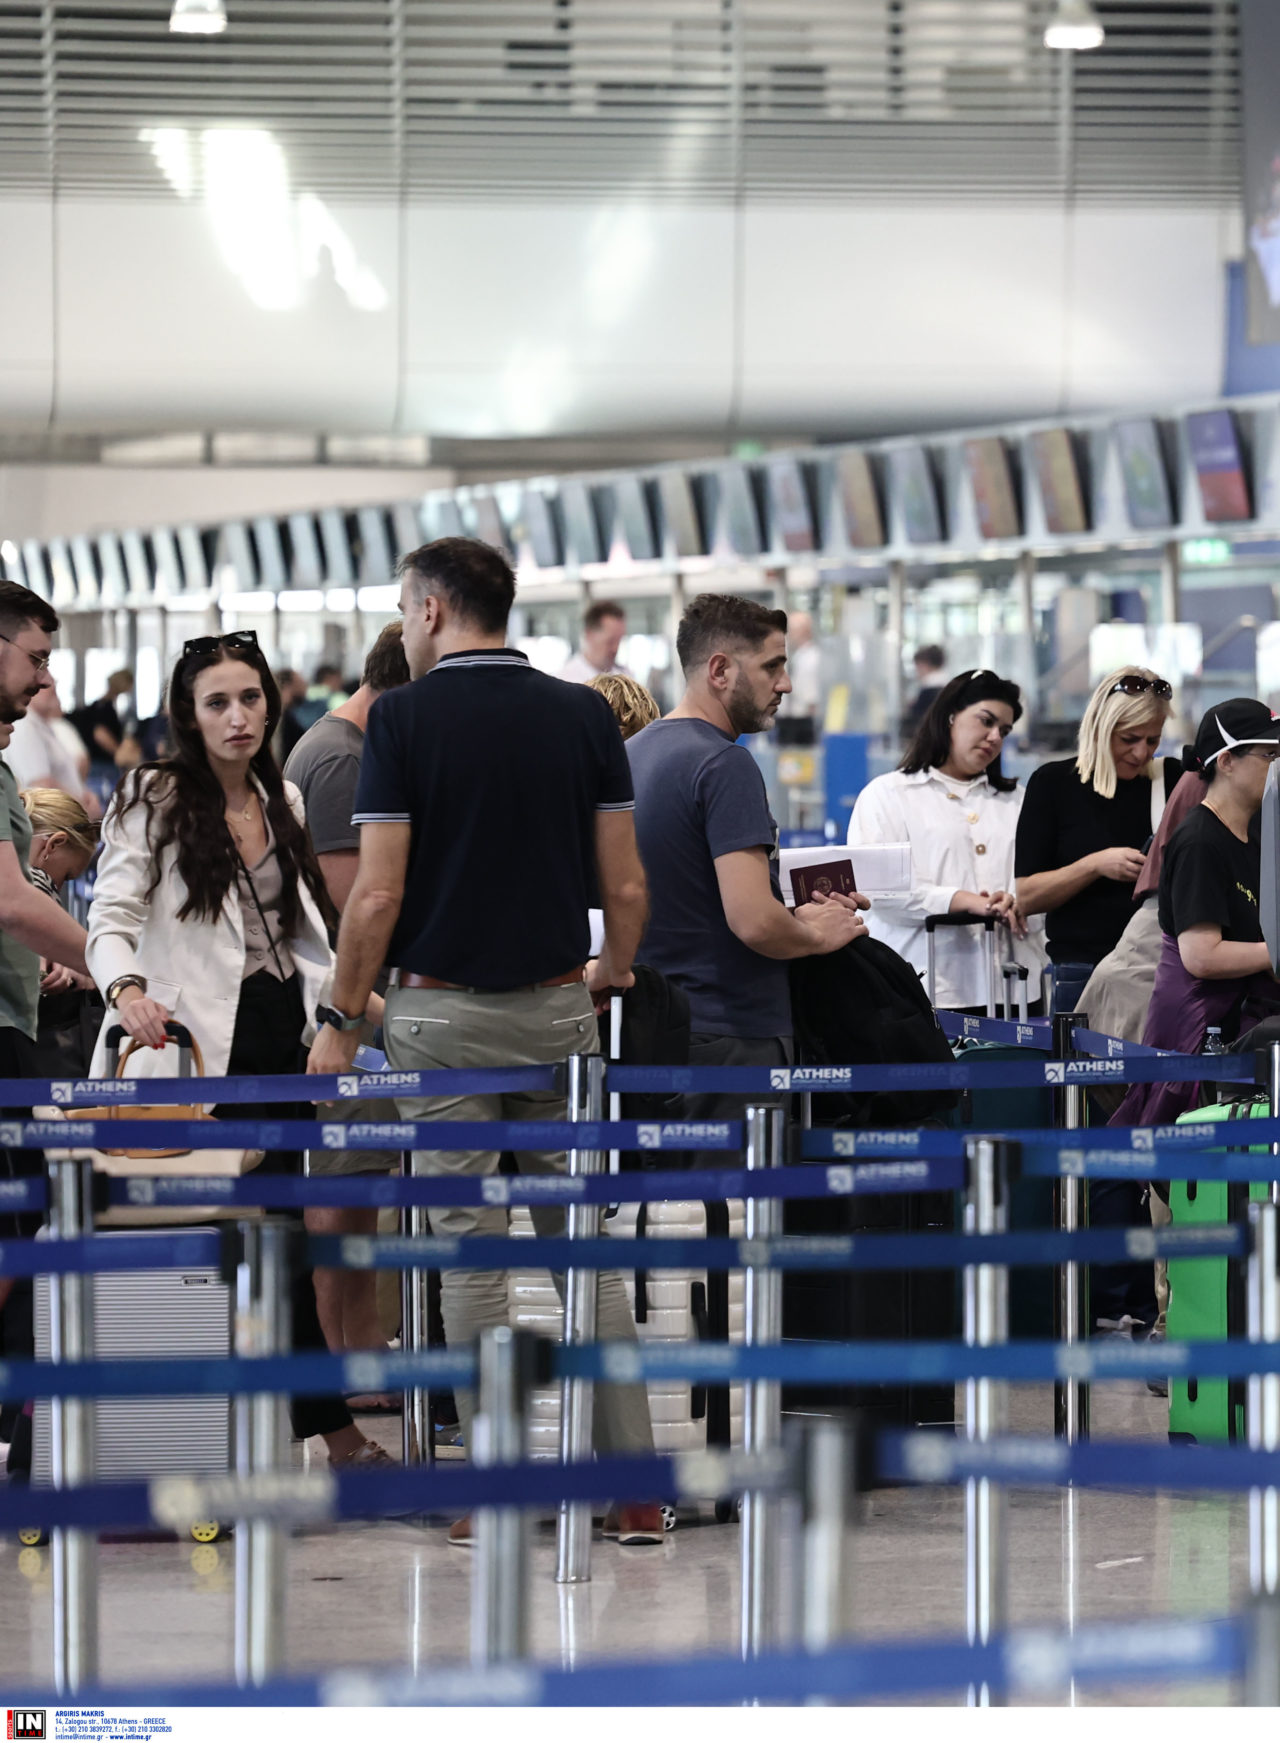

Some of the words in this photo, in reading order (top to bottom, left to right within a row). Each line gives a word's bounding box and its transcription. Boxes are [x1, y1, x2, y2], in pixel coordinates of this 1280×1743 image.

[792, 1068, 852, 1079] ATHENS
[1066, 1060, 1125, 1073] ATHENS
[360, 1072, 421, 1086] ATHENS
[74, 1081, 137, 1092] ATHENS
[24, 1122, 96, 1136] ATHENS
[348, 1124, 417, 1138] ATHENS
[662, 1124, 730, 1138] ATHENS
[1155, 1124, 1216, 1139] ATHENS
[857, 1132, 919, 1146] ATHENS
[1086, 1151, 1157, 1167] ATHENS
[856, 1161, 930, 1179] ATHENS
[510, 1177, 586, 1192] ATHENS
